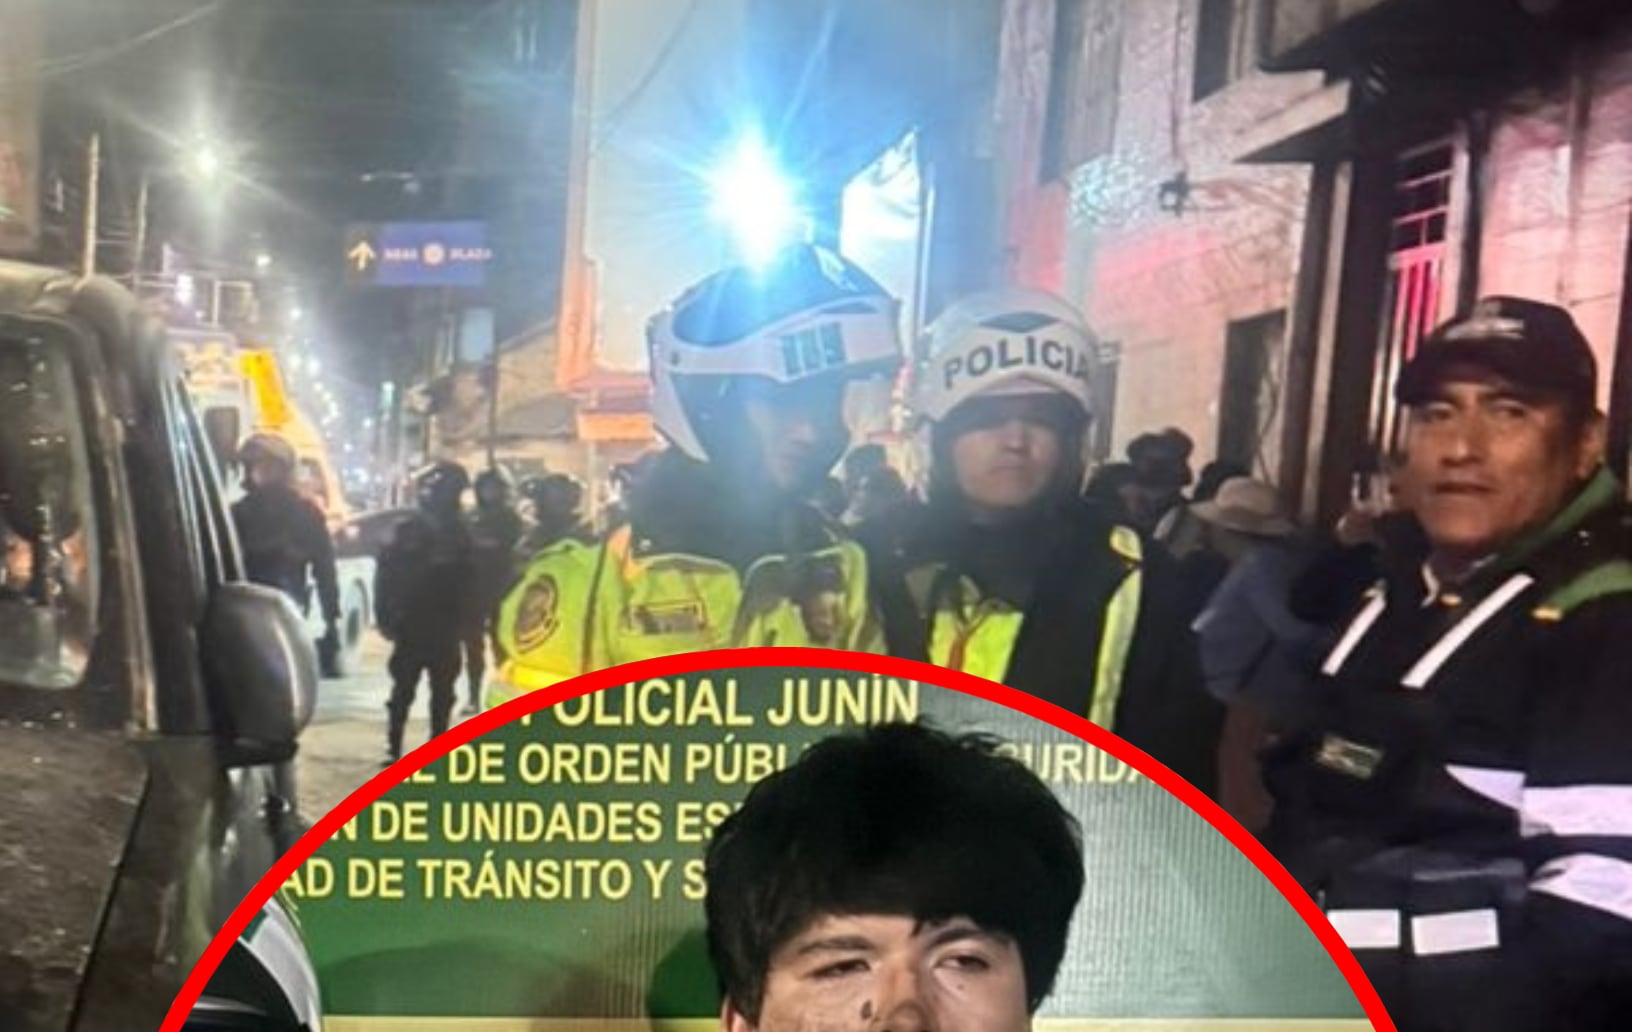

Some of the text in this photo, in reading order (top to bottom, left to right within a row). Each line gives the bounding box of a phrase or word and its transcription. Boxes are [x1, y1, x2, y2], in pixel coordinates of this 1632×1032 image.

[521, 677, 753, 726] OLICIAL
[448, 743, 505, 783] DE
[518, 742, 671, 784] ORDEN
[372, 802, 429, 841] DE
[443, 802, 662, 842] UNIDADES
[348, 858, 405, 898] DE
[417, 849, 632, 899] TRÁNSITO
[643, 859, 672, 899] Y
